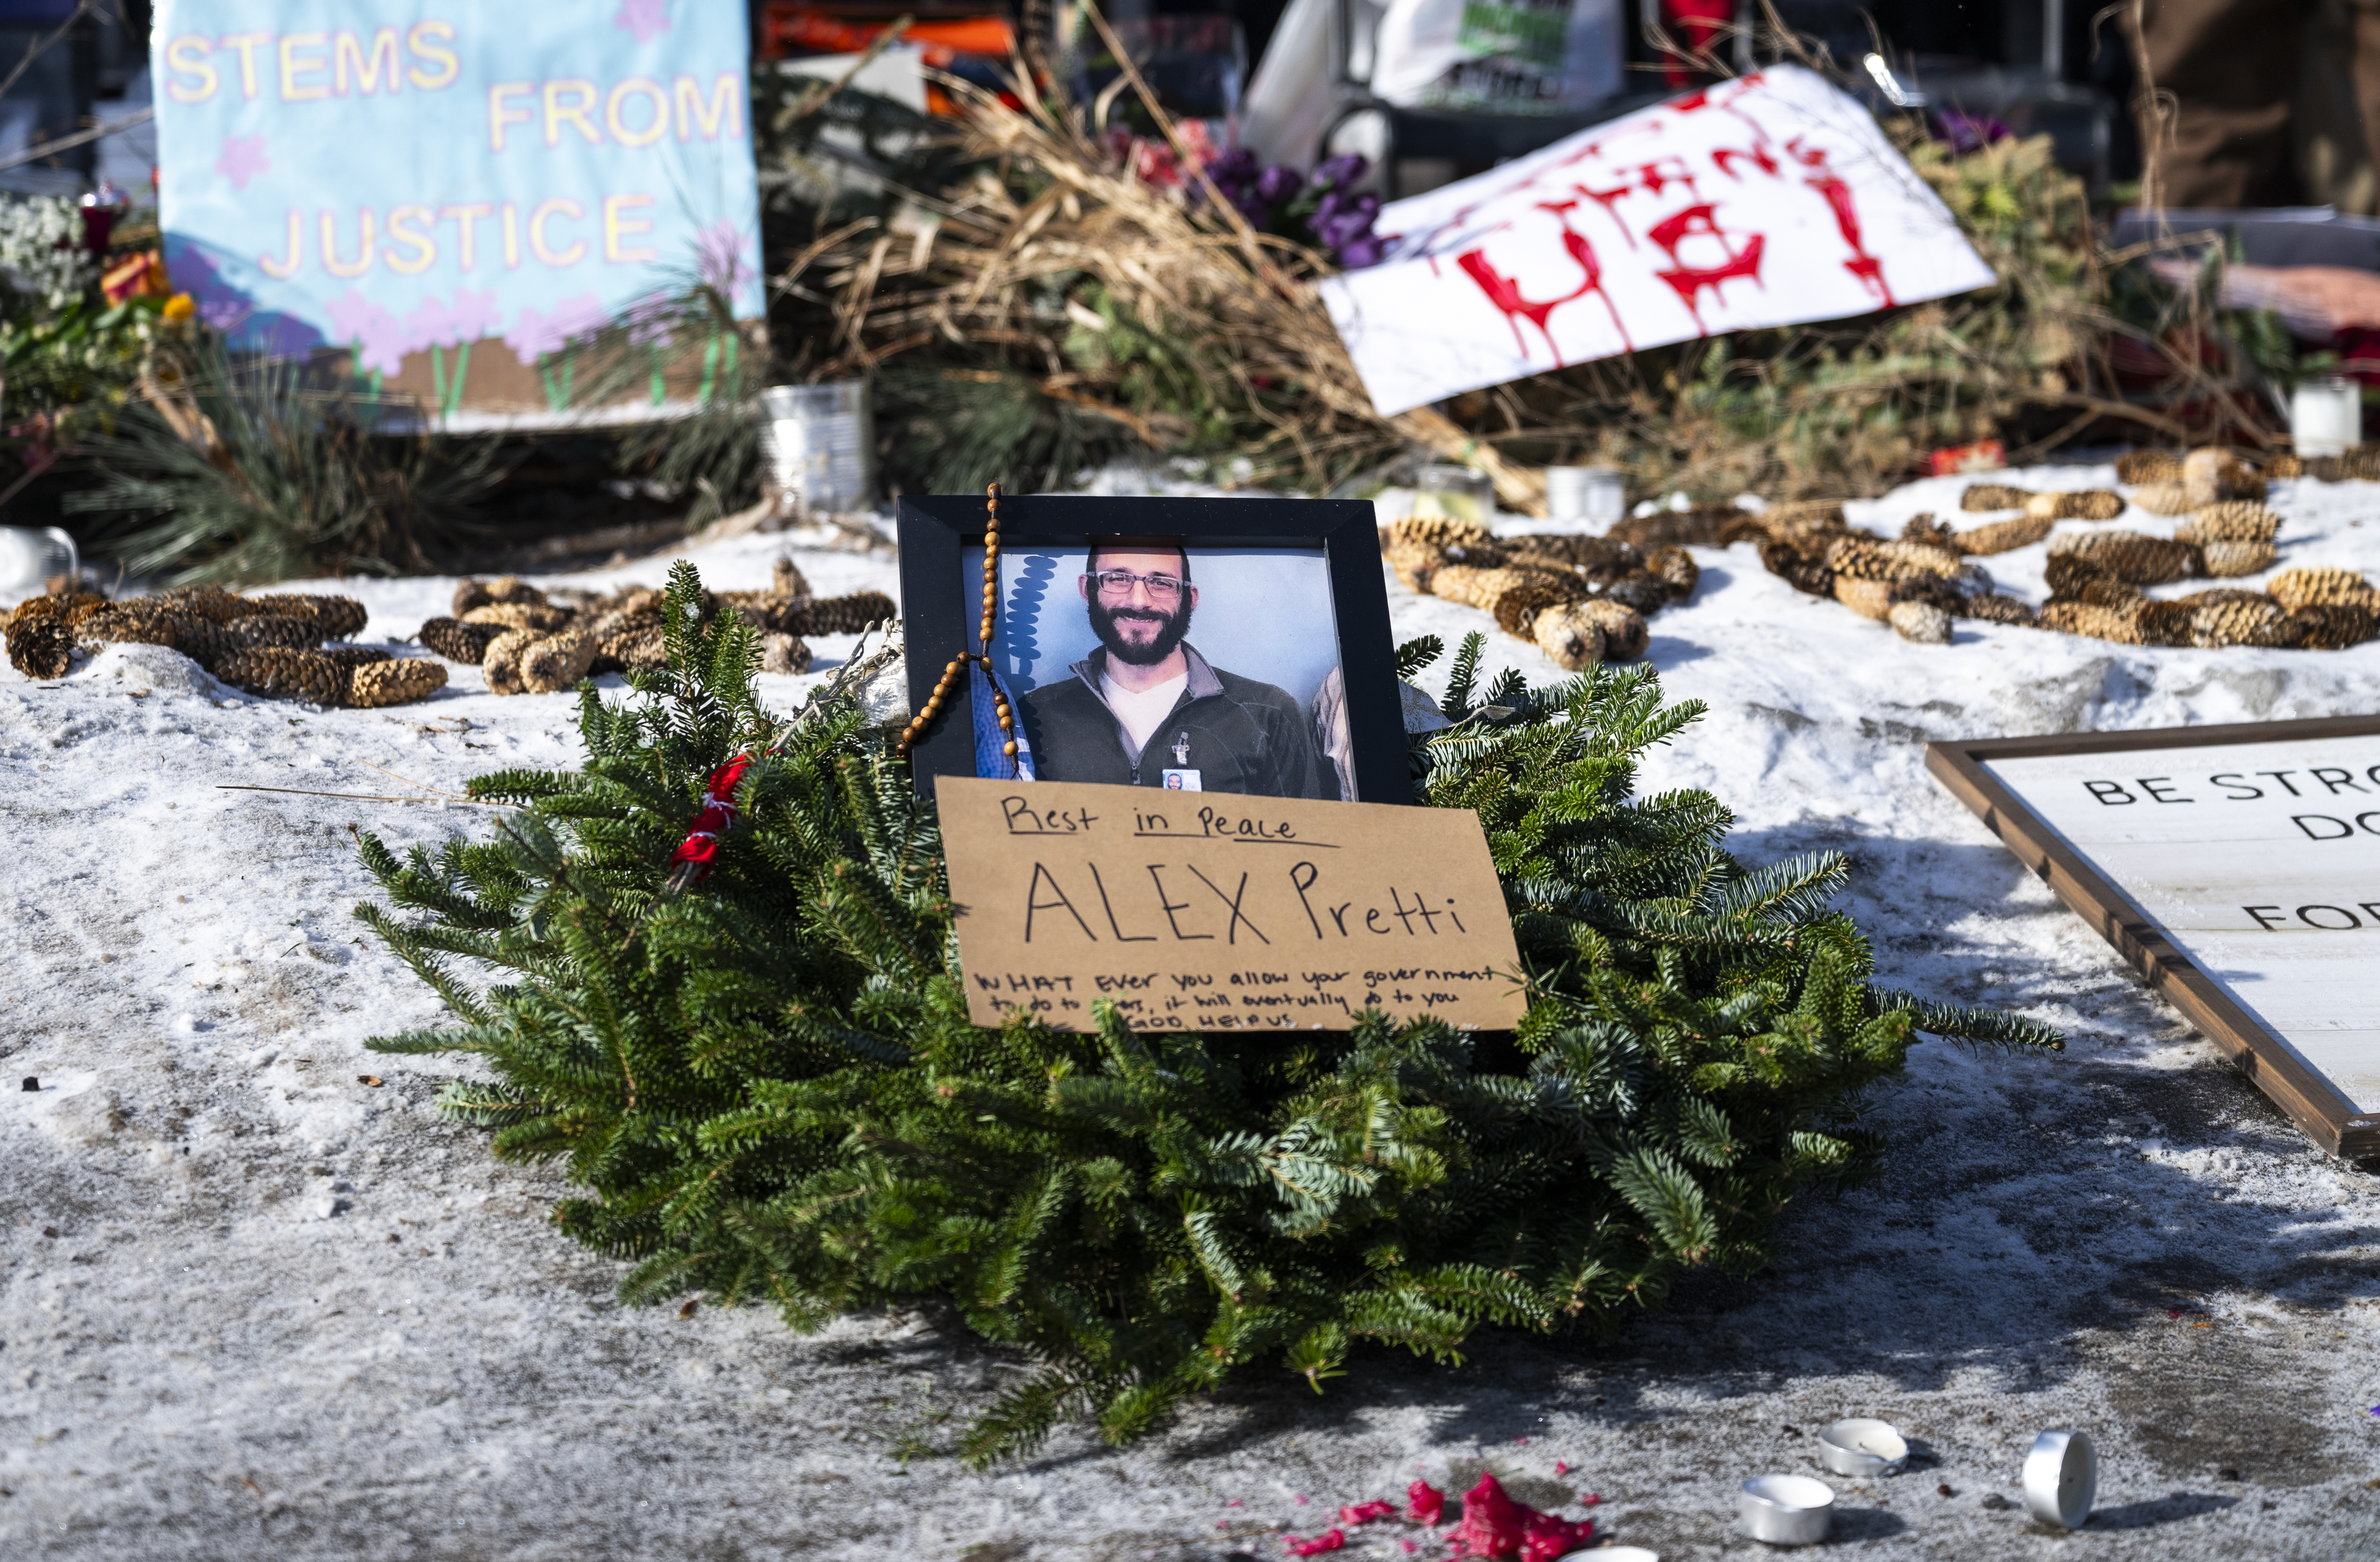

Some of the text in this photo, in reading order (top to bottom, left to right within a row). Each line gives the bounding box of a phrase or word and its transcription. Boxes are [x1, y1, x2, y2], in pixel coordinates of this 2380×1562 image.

[164, 21, 461, 105] STEMS
[487, 71, 746, 153] FROM
[258, 194, 660, 279] JUSTICE
[2082, 763, 2380, 806] BE STR
[1000, 795, 1298, 839] Rest in Peace
[1024, 861, 1467, 946] ALEX Pretti
[973, 972, 1074, 993] WHAT
[1170, 972, 1213, 992] you
[1229, 970, 1289, 986] allow
[1301, 970, 1351, 991] your
[1363, 964, 1494, 988] government
[1029, 994, 1052, 1011] do
[1060, 996, 1080, 1010] to
[1164, 995, 1188, 1011] it
[1242, 992, 1351, 1015] eventually
[1393, 989, 1413, 1003] to
[1421, 991, 1460, 1007] you
